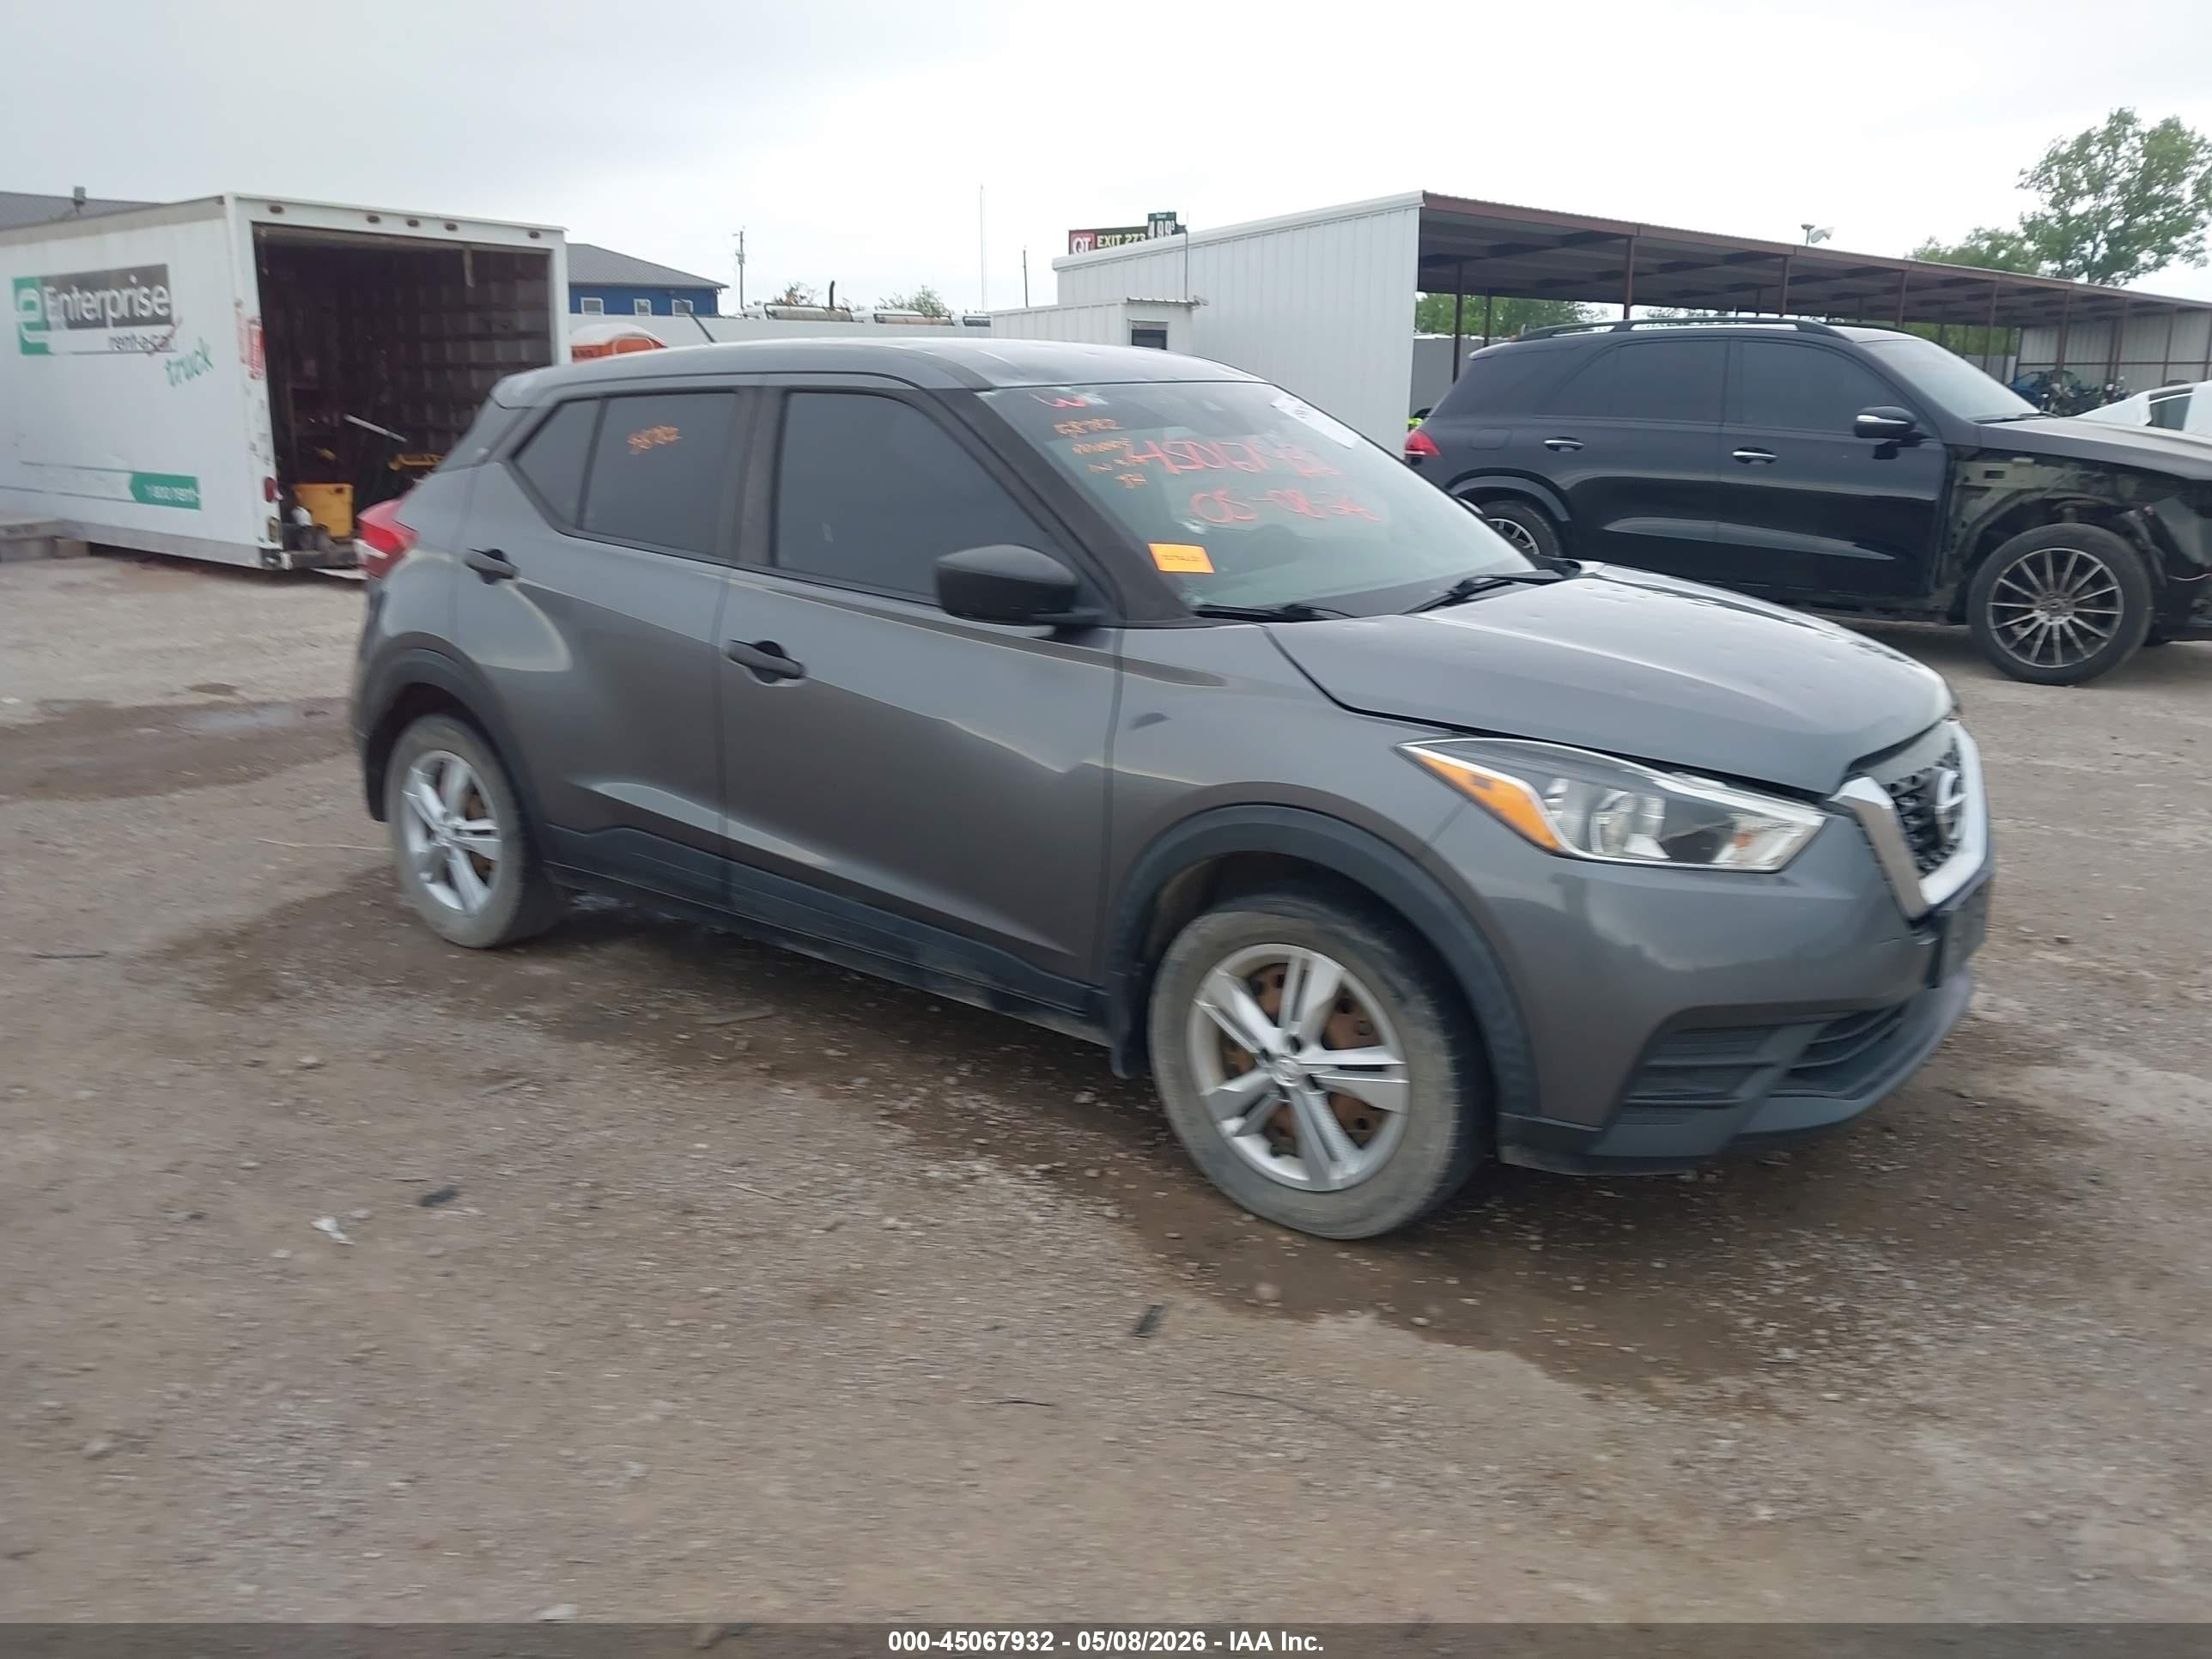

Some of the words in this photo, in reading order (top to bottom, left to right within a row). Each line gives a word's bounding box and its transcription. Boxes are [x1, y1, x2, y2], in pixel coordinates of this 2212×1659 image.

[1073, 237, 1091, 254] QT
[1097, 234, 1122, 247] EXIT
[43, 274, 171, 329] Enterprise
[164, 336, 214, 386] truck
